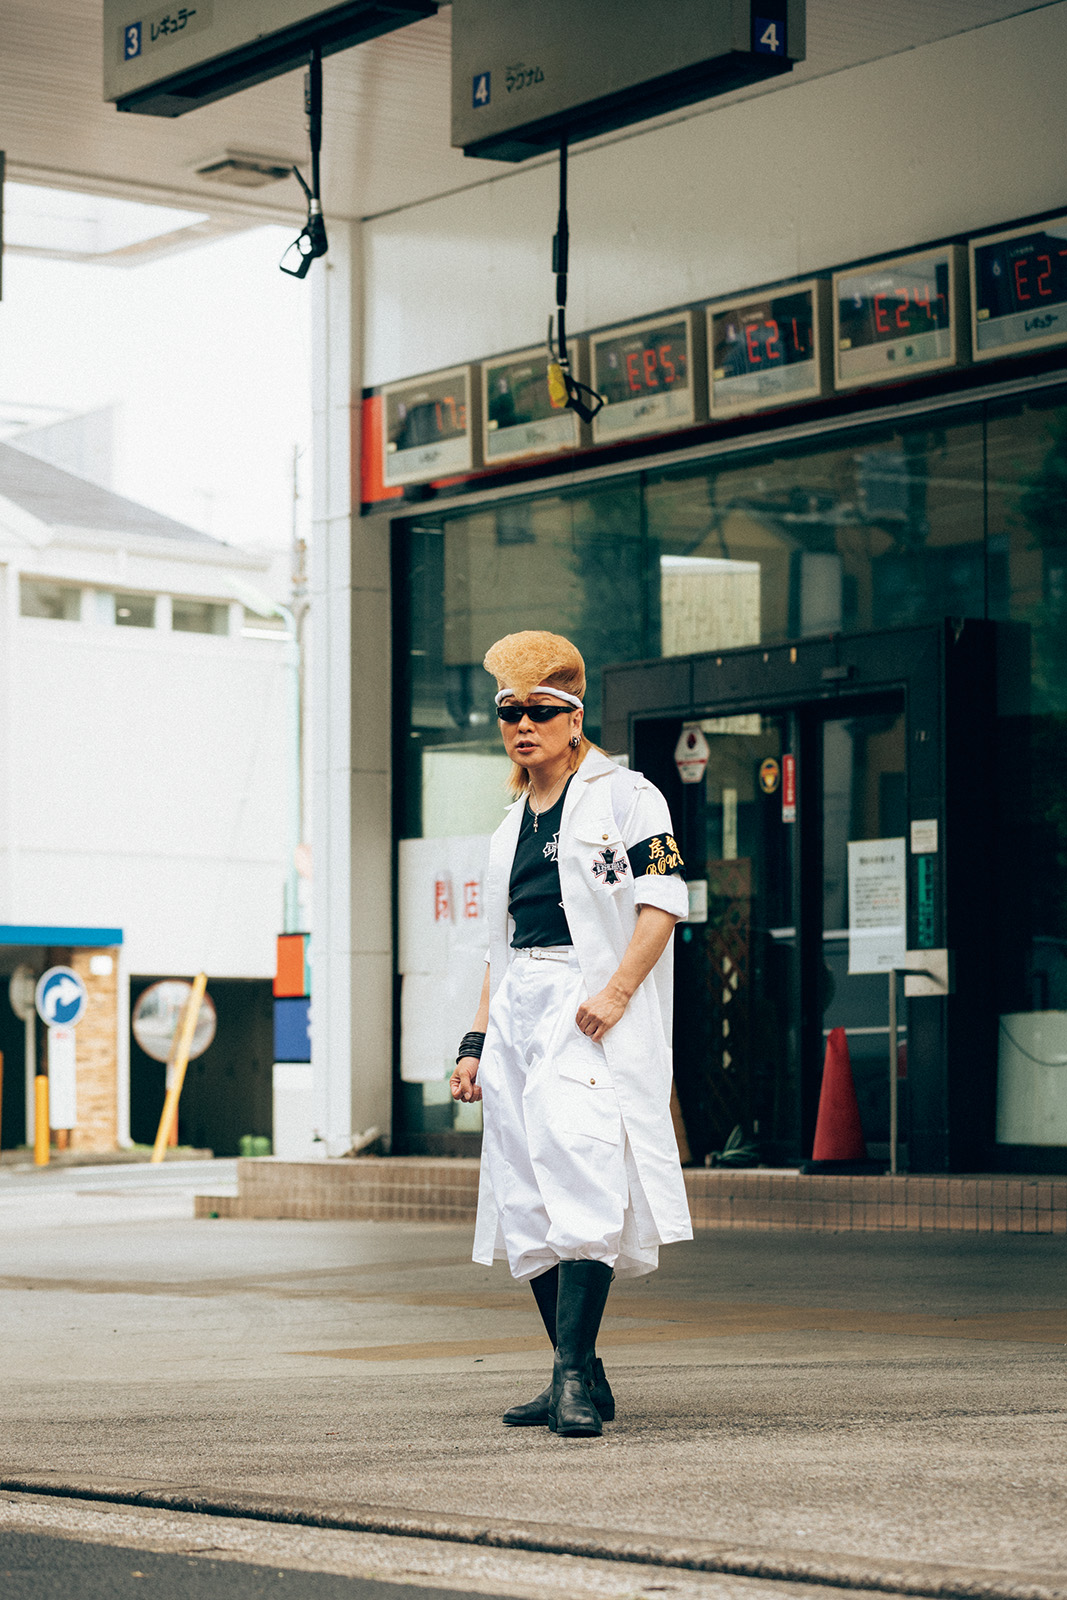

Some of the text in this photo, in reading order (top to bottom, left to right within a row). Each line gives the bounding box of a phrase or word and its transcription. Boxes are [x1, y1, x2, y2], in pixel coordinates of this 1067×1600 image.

[127, 23, 139, 56] 3
[150, 8, 197, 43] レギュラー
[759, 22, 780, 52] 4
[474, 76, 489, 104] 4
